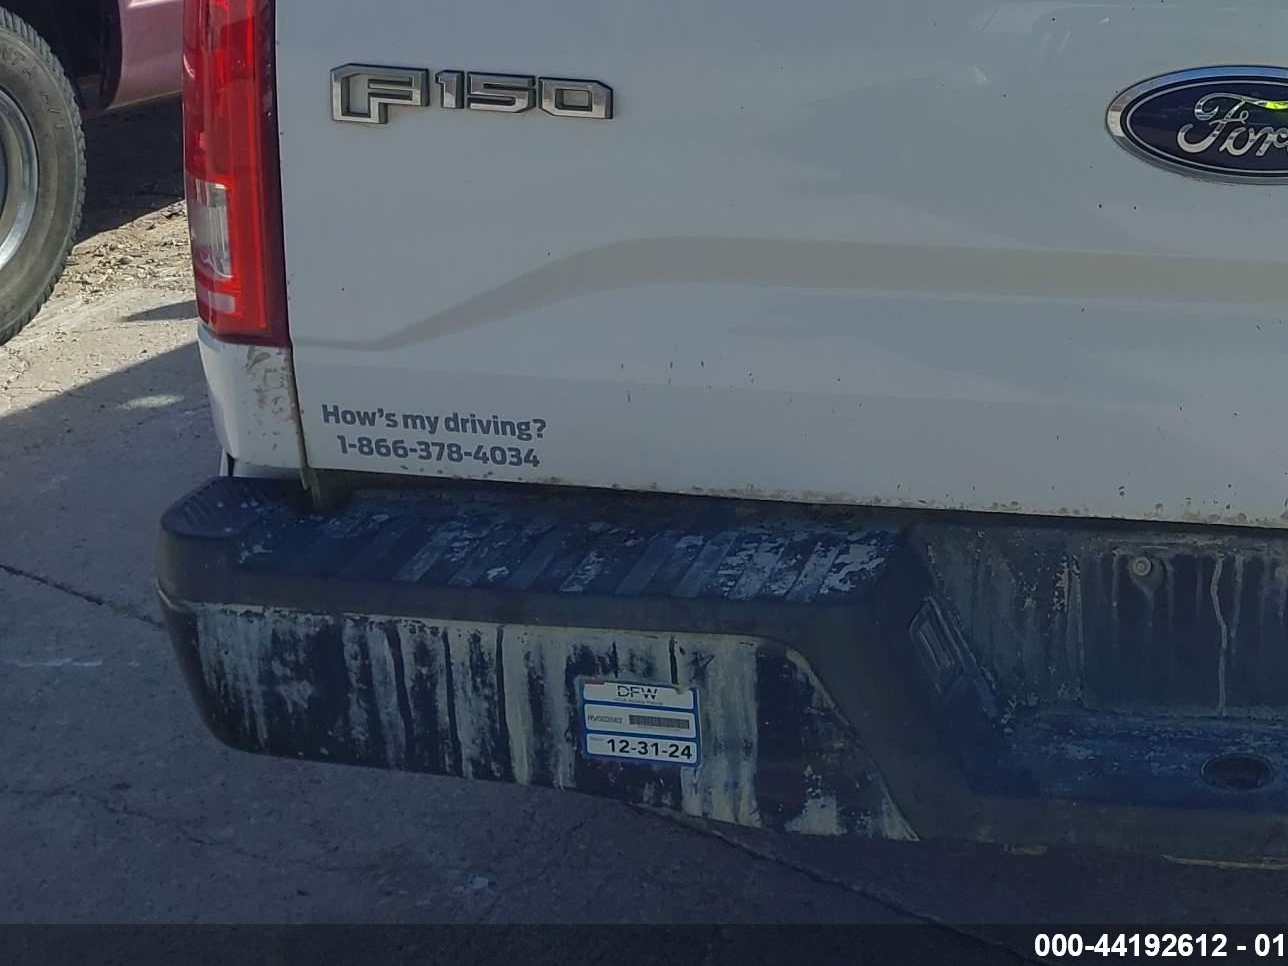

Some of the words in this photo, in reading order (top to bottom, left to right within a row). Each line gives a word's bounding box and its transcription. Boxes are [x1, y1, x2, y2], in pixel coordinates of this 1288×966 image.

[402, 413, 440, 434] my
[444, 412, 547, 441] driving?
[337, 434, 540, 467] 1-866-378-4034
[617, 685, 658, 700] DFW
[607, 739, 692, 760] 12-31-24
